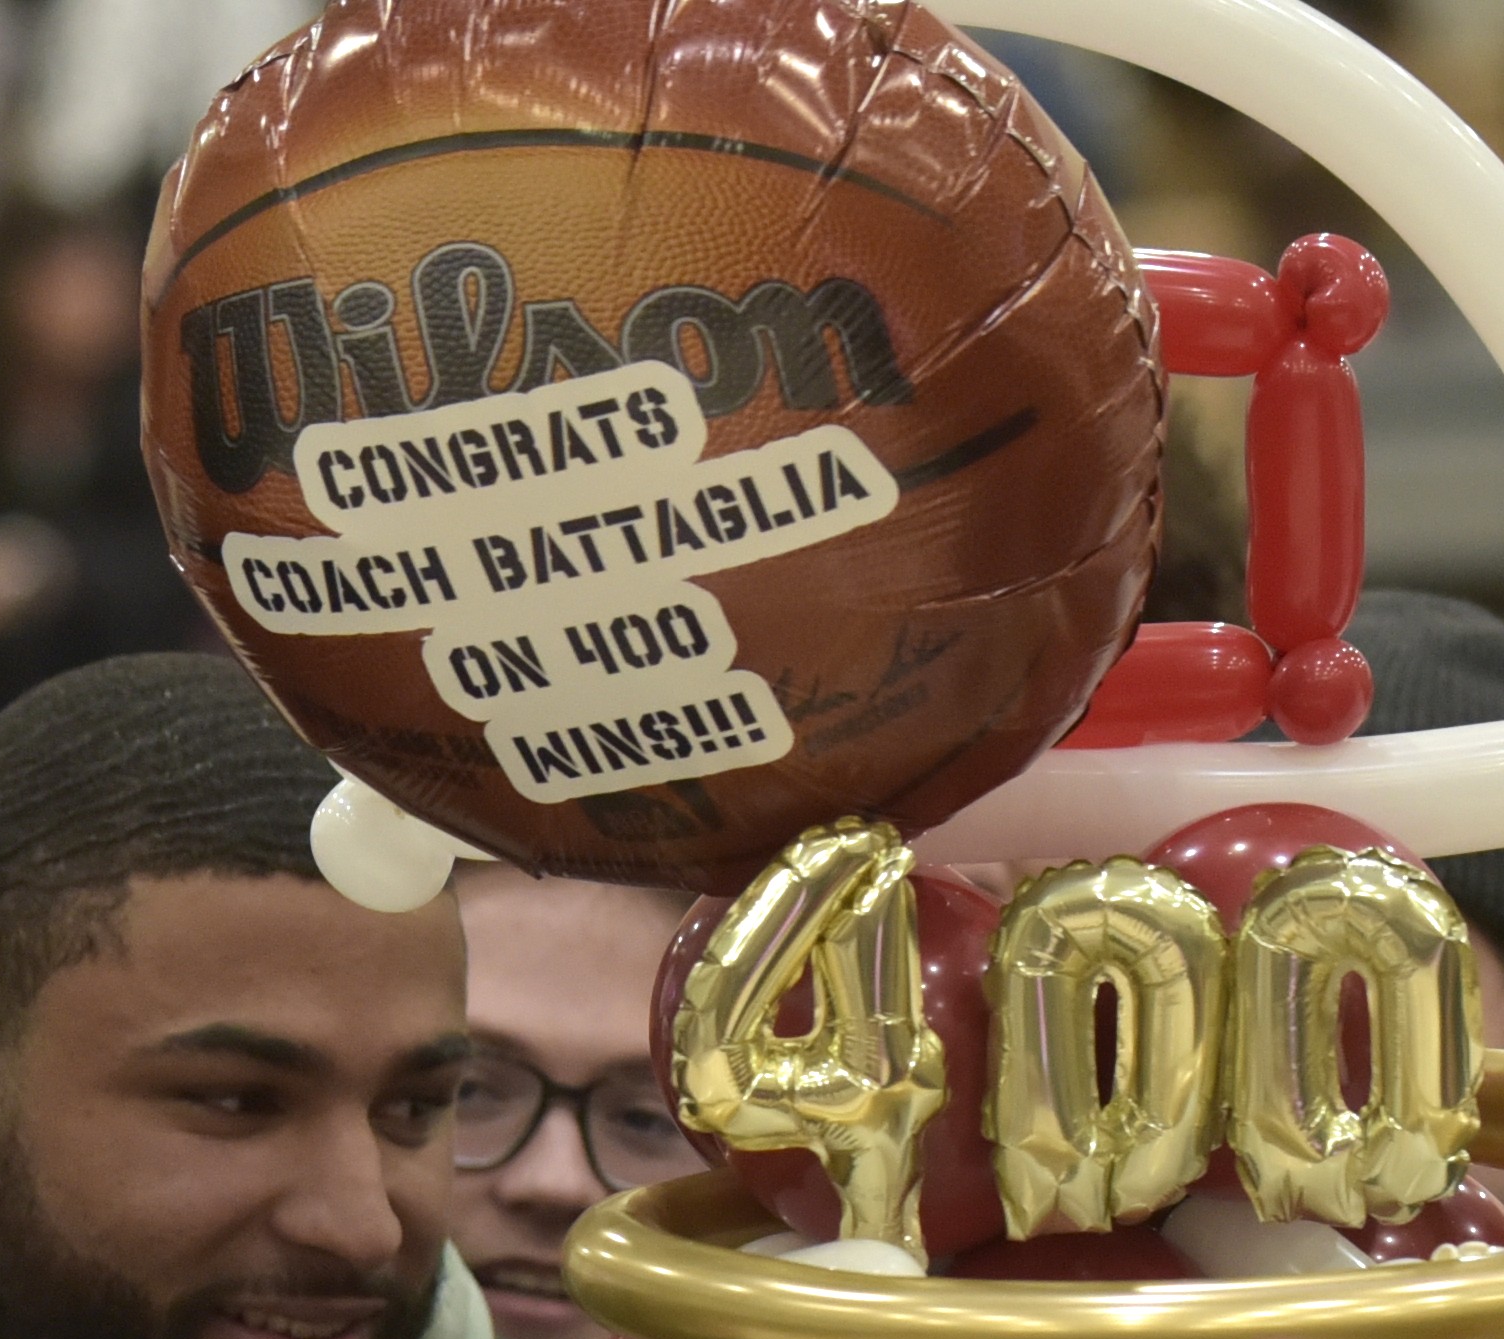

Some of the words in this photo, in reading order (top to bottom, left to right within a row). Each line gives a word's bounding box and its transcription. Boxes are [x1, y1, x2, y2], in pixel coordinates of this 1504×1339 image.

[181, 240, 916, 494] Wilson
[318, 386, 680, 510] CONGRATS
[240, 544, 455, 614] COACH
[472, 449, 871, 593] BATTAGLIA
[448, 634, 550, 701] ON
[565, 603, 710, 674] 400
[512, 692, 768, 785] WINS!!!
[670, 815, 1485, 1277] 400
